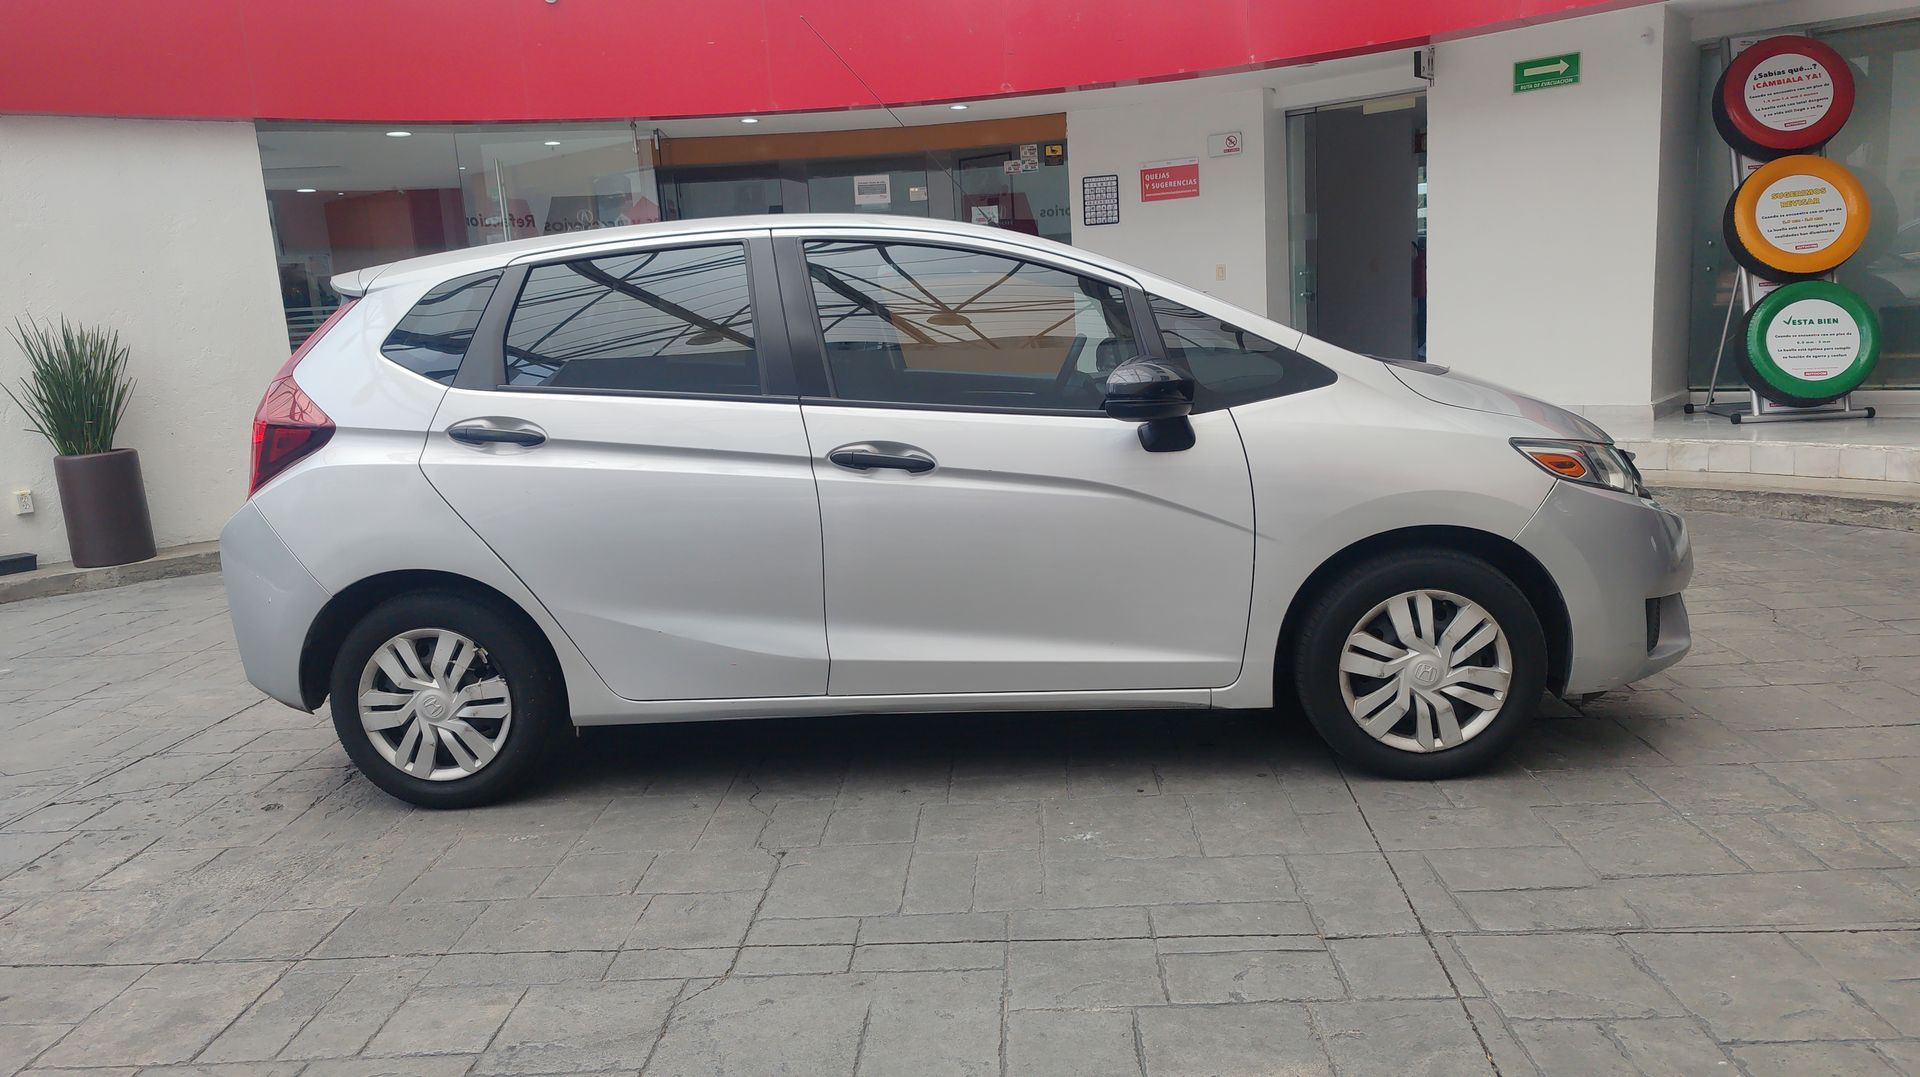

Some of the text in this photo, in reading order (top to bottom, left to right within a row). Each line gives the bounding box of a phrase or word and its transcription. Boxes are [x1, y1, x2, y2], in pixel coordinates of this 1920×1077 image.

[1753, 70, 1786, 81] ¿Sabías
[1805, 72, 1822, 81] YA!
[1145, 172, 1170, 182] QUEJAS
[1151, 178, 1197, 190] SUGERENCIAS
[1770, 187, 1827, 200] SUGERIMOS
[1780, 197, 1821, 208] REVISAR
